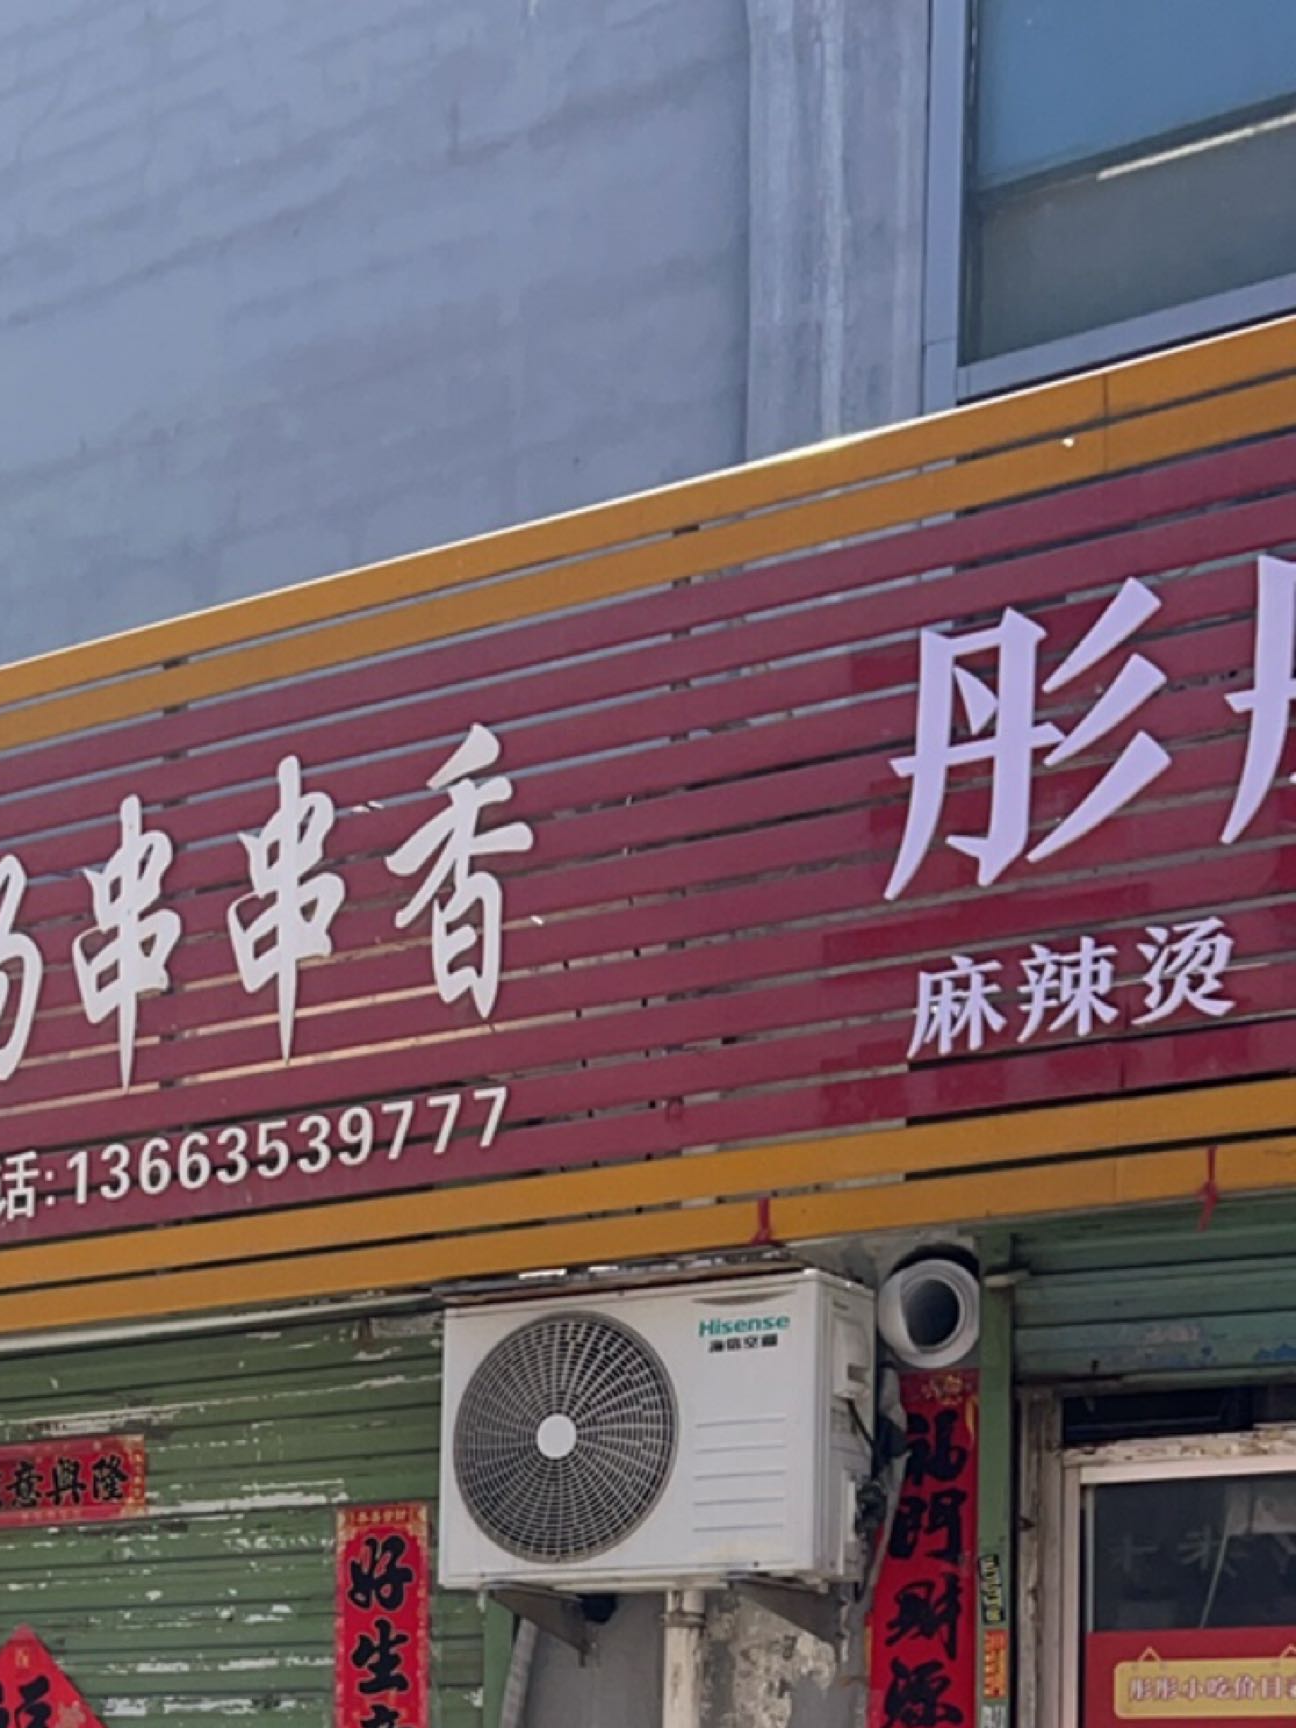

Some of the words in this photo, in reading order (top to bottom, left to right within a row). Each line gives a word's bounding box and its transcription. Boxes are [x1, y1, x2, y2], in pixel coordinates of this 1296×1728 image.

[907, 916, 1235, 1058] 麻辣烫
[698, 1316, 791, 1338] Hisense
